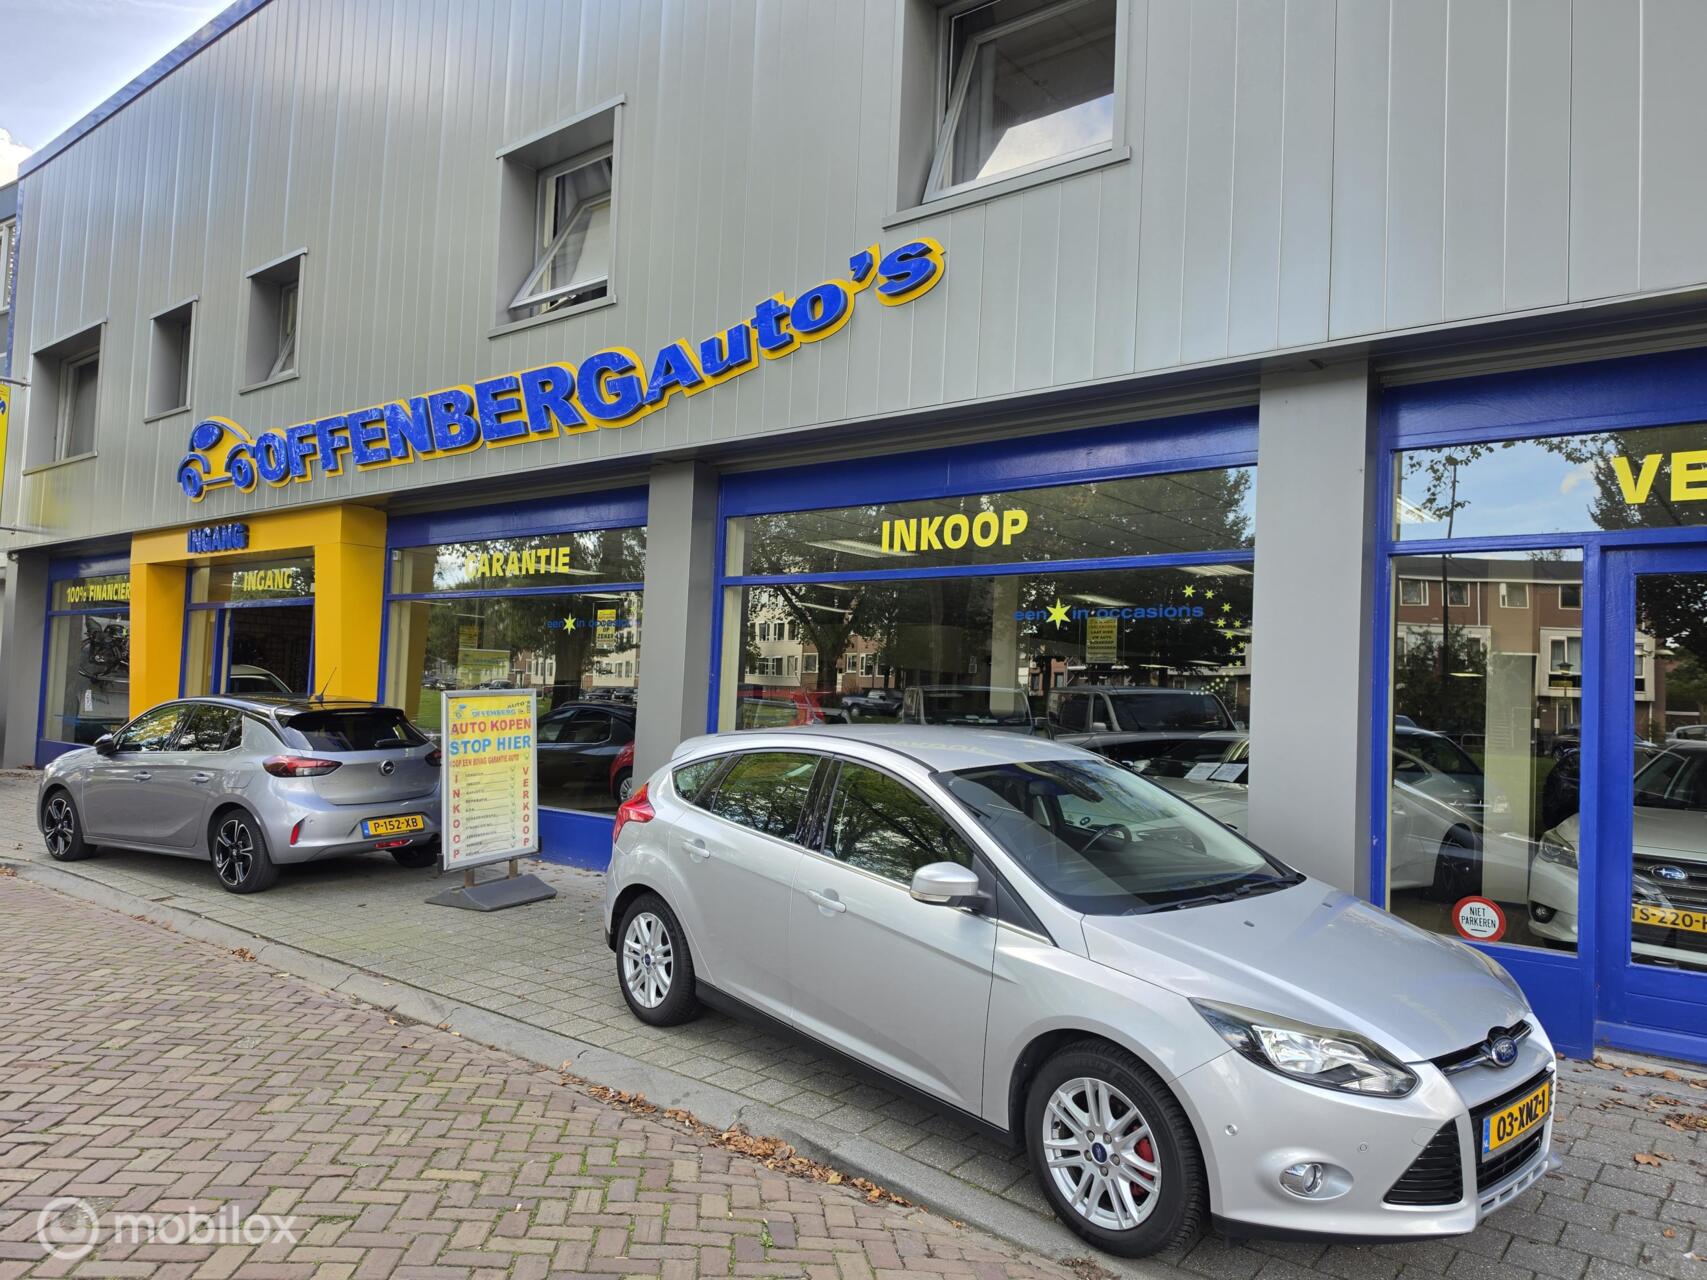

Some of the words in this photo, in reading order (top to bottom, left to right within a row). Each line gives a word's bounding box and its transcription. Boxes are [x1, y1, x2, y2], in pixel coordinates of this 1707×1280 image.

[254, 346, 648, 484] OFFENBERG
[187, 522, 249, 553] INGANG
[881, 509, 1029, 553] INKOOP
[464, 546, 571, 579] GARANTIE
[243, 568, 293, 592] INGANG
[66, 586, 87, 603] 100%
[1013, 608, 1048, 621] een
[1072, 606, 1089, 620] in
[1096, 604, 1205, 620] occasions
[451, 720, 487, 736] AUTO
[490, 718, 531, 732] KOPEN
[449, 738, 492, 755] STOP
[496, 735, 531, 751] HIER
[522, 766, 530, 847] VERKOOP
[373, 815, 418, 833] P-152-XB
[1461, 915, 1497, 929] PARKEREN
[1469, 906, 1486, 917] NIET
[1496, 1089, 1546, 1142] 03-XNZ-1
